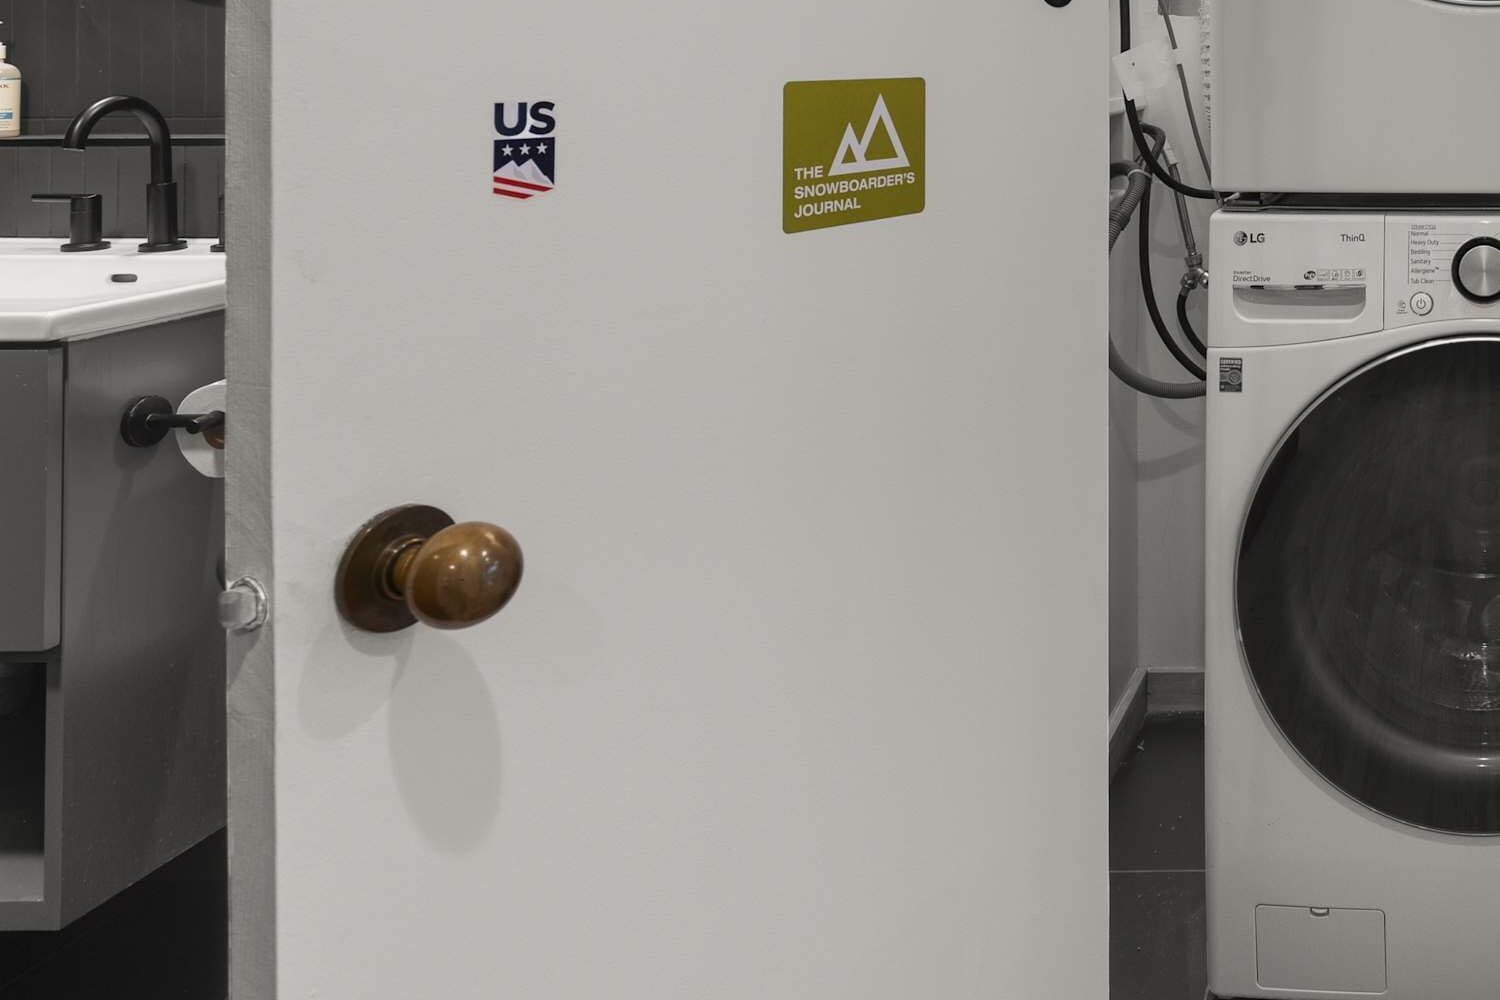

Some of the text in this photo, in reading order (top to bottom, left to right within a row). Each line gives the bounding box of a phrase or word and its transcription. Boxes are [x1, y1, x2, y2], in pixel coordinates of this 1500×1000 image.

[494, 101, 556, 137] US
[794, 165, 824, 180] THE
[794, 172, 916, 199] SNOWBOARDER'S
[794, 197, 862, 218] JOURNAL
[1250, 232, 1266, 244] LG
[1341, 233, 1366, 243] ThinQ
